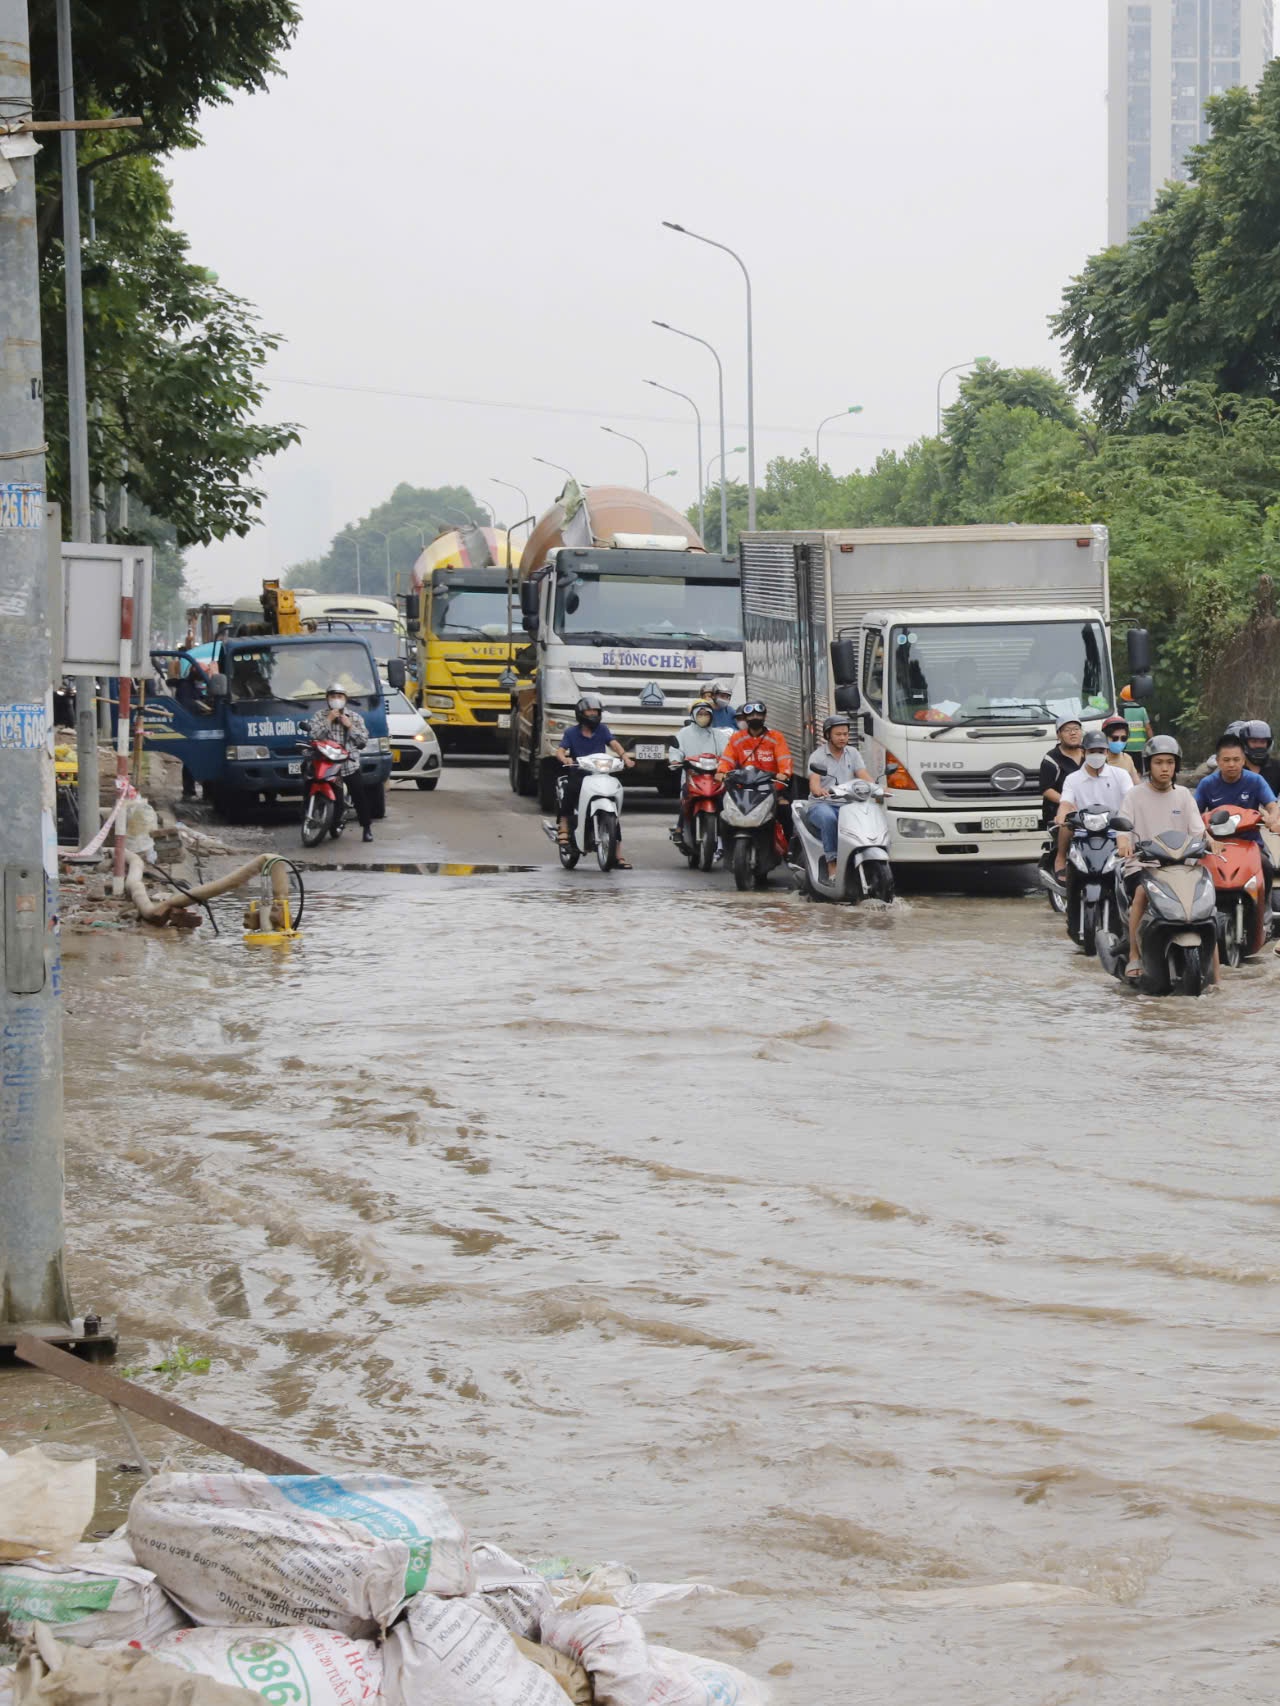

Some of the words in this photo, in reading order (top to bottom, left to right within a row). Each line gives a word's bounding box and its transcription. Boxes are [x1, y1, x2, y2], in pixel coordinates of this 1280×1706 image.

[648, 652, 697, 669] CHÈM
[247, 722, 258, 737] XE
[920, 761, 964, 769] HINO
